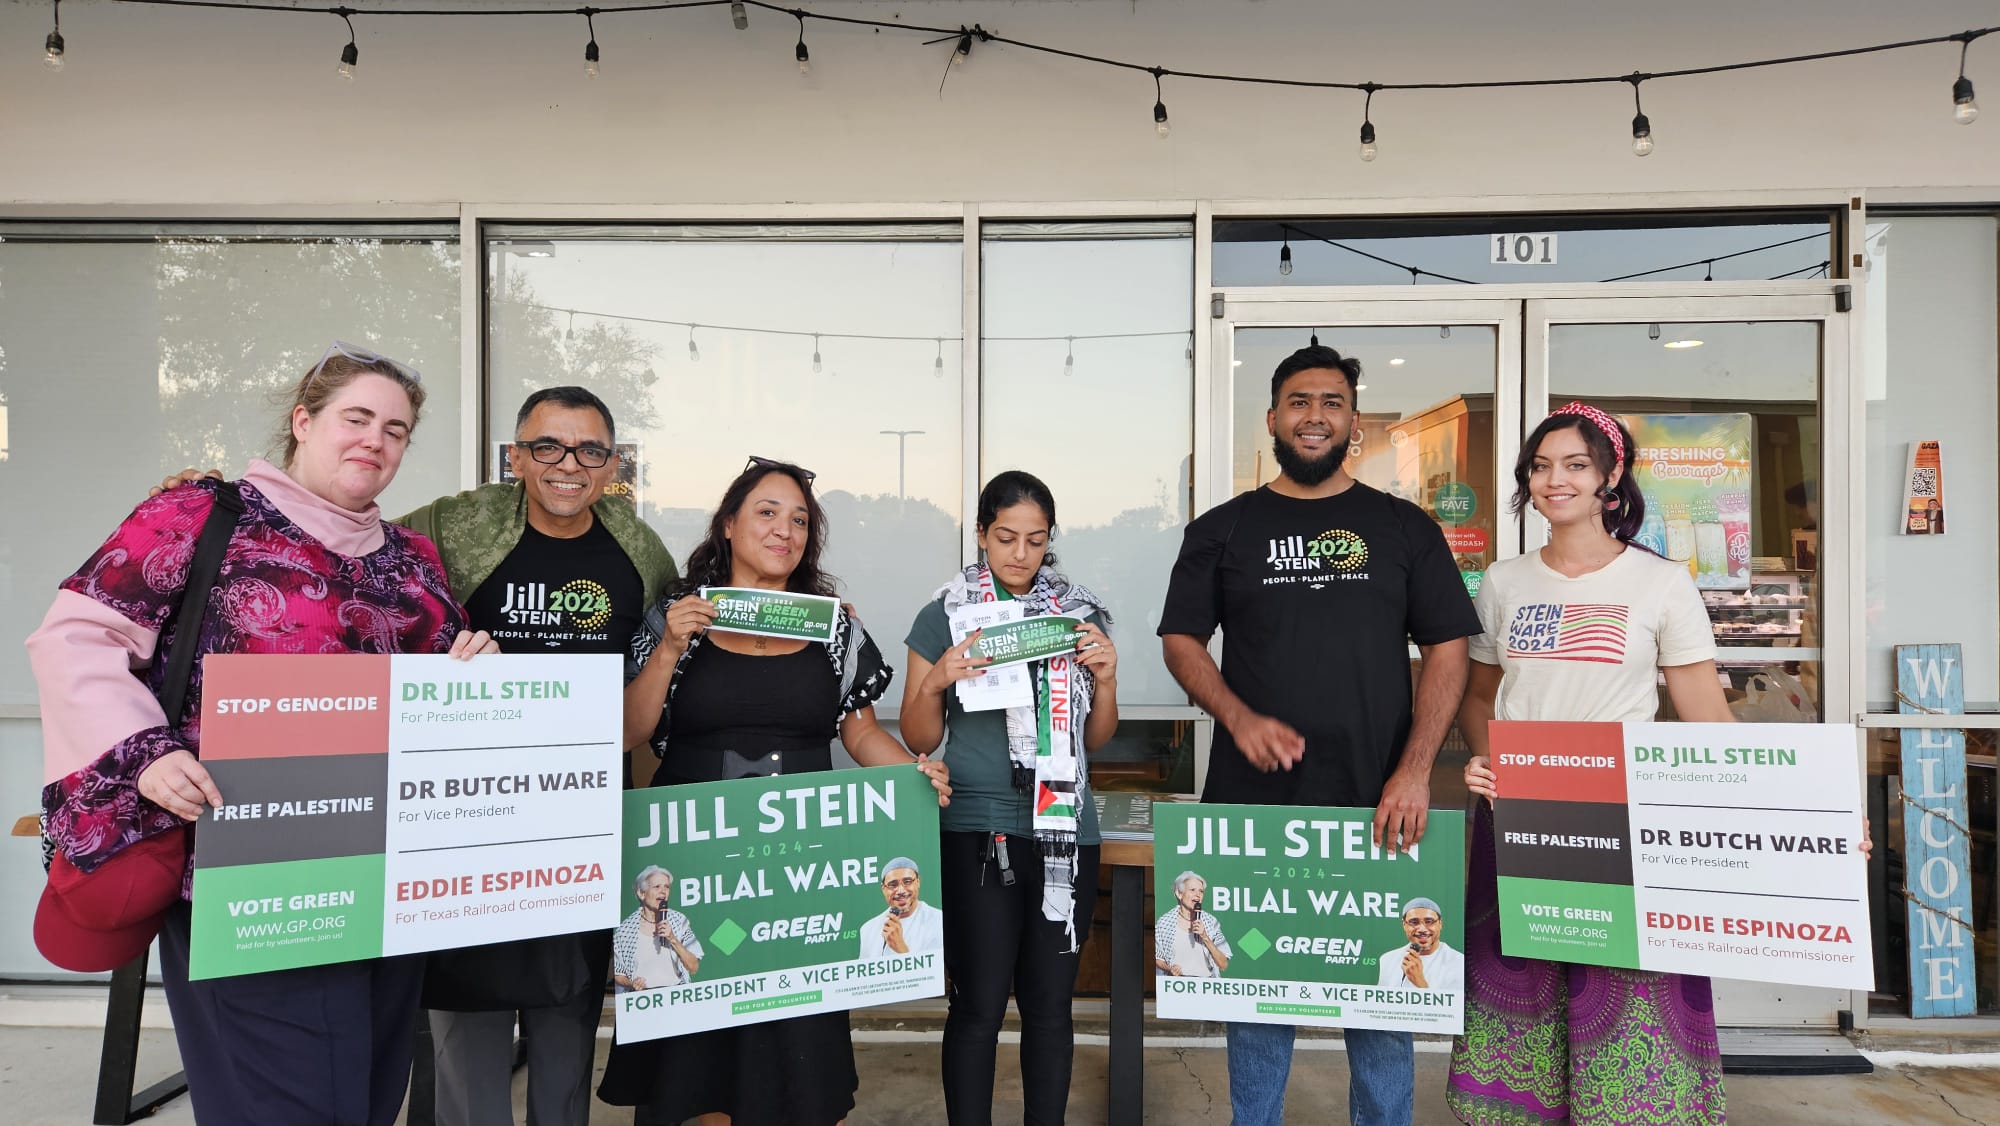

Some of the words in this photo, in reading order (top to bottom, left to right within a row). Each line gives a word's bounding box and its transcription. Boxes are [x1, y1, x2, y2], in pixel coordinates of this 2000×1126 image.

[1496, 236, 1551, 262] 101
[1653, 461, 1725, 486] Beverages
[1442, 501, 1469, 509] FAVE
[1267, 536, 1304, 563] Jill
[1307, 540, 1363, 556] 2024
[1274, 557, 1320, 570] STEIN
[501, 583, 545, 614] Jill
[548, 590, 608, 613] 2024
[718, 599, 759, 612] STEIN
[508, 610, 561, 625] STEIN
[720, 610, 756, 621] WARE
[763, 604, 809, 617] GREEN
[1516, 604, 1563, 621] STEIN
[764, 615, 803, 626] PARTY
[804, 621, 828, 629] gp.org
[1007, 624, 1026, 632] VOTE
[1511, 621, 1559, 637] WARE
[493, 630, 530, 638] PEOPLE
[537, 632, 573, 640] PLANET
[979, 633, 1018, 649] STEIN
[1021, 624, 1064, 640] GREEN
[982, 644, 1018, 657] WARE
[1026, 634, 1063, 649] PARTY
[1509, 635, 1555, 651] 2024
[402, 682, 438, 701] DR
[444, 681, 492, 705] JILL
[501, 680, 570, 699] STEIN
[217, 698, 271, 714] STOP
[277, 696, 377, 713] GENOCIDE
[401, 711, 422, 723] For
[427, 709, 488, 722] President
[492, 708, 522, 720] 2024
[1500, 754, 1535, 766] STOP
[1540, 755, 1615, 768] GENOCIDE
[1635, 747, 1666, 762] DR
[1670, 747, 1716, 768] JILL
[1724, 748, 1796, 766] STEIN
[400, 780, 436, 800] DR
[445, 774, 530, 797] BUTCH
[539, 770, 608, 791] WARE
[1636, 771, 1655, 781] For
[1658, 772, 1714, 784] President
[1718, 773, 1747, 784] 2024
[213, 804, 262, 821] FREE
[268, 797, 373, 817] PALESTINE
[398, 810, 420, 823] For
[424, 808, 451, 821] Vice
[455, 804, 515, 819] President
[638, 796, 739, 848] JILL
[758, 780, 896, 833] STEIN
[1177, 817, 1266, 857] JILL
[1906, 658, 1963, 1001] WELCOME
[747, 841, 802, 858] 2024
[1505, 832, 1537, 845] FREE
[1541, 834, 1620, 850] PALESTINE
[1640, 829, 1671, 845] DR
[1680, 831, 1762, 851] BUTCH
[1770, 834, 1848, 854] WARE
[1642, 854, 1659, 864] For
[1662, 855, 1688, 866] Vice
[1691, 856, 1749, 869] President
[680, 869, 774, 907] BILAL
[784, 856, 878, 893] WARE
[1273, 867, 1325, 879] 2024
[396, 876, 473, 902] EDDIE
[481, 863, 604, 894] ESPINOZA
[228, 897, 283, 916] VOTE
[289, 890, 355, 910] GREEN
[396, 911, 416, 924] For
[421, 908, 459, 921] Texas
[463, 901, 515, 917] Railroad
[519, 892, 605, 911] Commissioner
[1213, 887, 1296, 914] BILAL
[1308, 890, 1399, 918] WARE
[1522, 904, 1560, 919] VOTE
[1563, 908, 1613, 923] GREEN
[236, 916, 345, 938] WWW.GP.ORG
[752, 912, 842, 942] GREEN
[1529, 923, 1608, 939] WWW.GP.ORG
[1646, 911, 1714, 933] EDDIE
[1722, 917, 1852, 943] ESPINOZA
[236, 942, 252, 950] Paid
[267, 939, 275, 947] by
[804, 932, 839, 945] PARTY
[843, 929, 857, 940] US
[1275, 936, 1363, 957] GREEN
[1648, 937, 1666, 948] For
[1670, 938, 1704, 952] Texas
[1708, 942, 1759, 956] Railroad
[1762, 946, 1855, 963] Commissioner
[1325, 956, 1359, 965] PARTY
[1363, 957, 1376, 966] US
[625, 994, 662, 1012] FOR
[670, 978, 766, 1005] PRESIDENT
[779, 974, 791, 988] &
[802, 967, 839, 985] VICE
[846, 954, 934, 979] PRESIDENT
[1164, 980, 1197, 994] FOR
[1203, 983, 1288, 998] PRESIDENT
[1299, 986, 1312, 999] &
[1322, 987, 1358, 1002] VICE
[1365, 991, 1455, 1007] PRESIDENT
